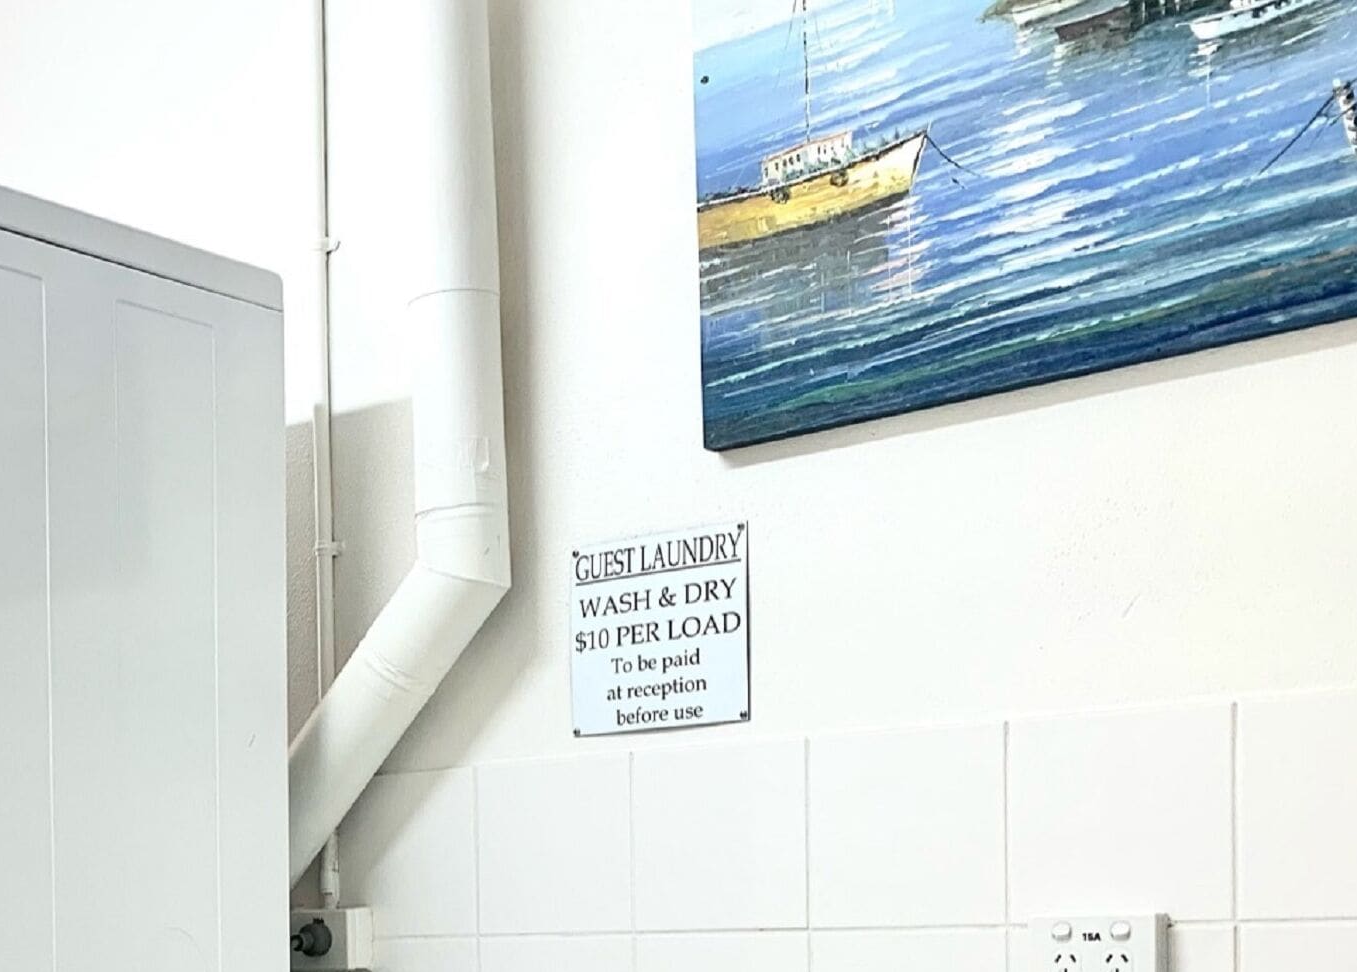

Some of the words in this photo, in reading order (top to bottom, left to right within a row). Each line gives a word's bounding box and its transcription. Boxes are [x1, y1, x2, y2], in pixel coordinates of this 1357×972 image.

[575, 547, 635, 582] GUEST
[640, 530, 742, 572] LAUNDRY
[579, 589, 652, 618] WASH
[658, 586, 676, 608] &
[684, 577, 737, 605] DRY
[575, 628, 610, 653] $10
[616, 621, 660, 647] PER
[668, 611, 742, 641] LOAD
[611, 657, 633, 674] To
[637, 654, 657, 672] be
[662, 648, 701, 673] paid
[606, 685, 622, 701] at
[627, 677, 707, 700] reception
[616, 706, 669, 726] before
[674, 705, 704, 720] use
[1082, 932, 1101, 942] 15A
